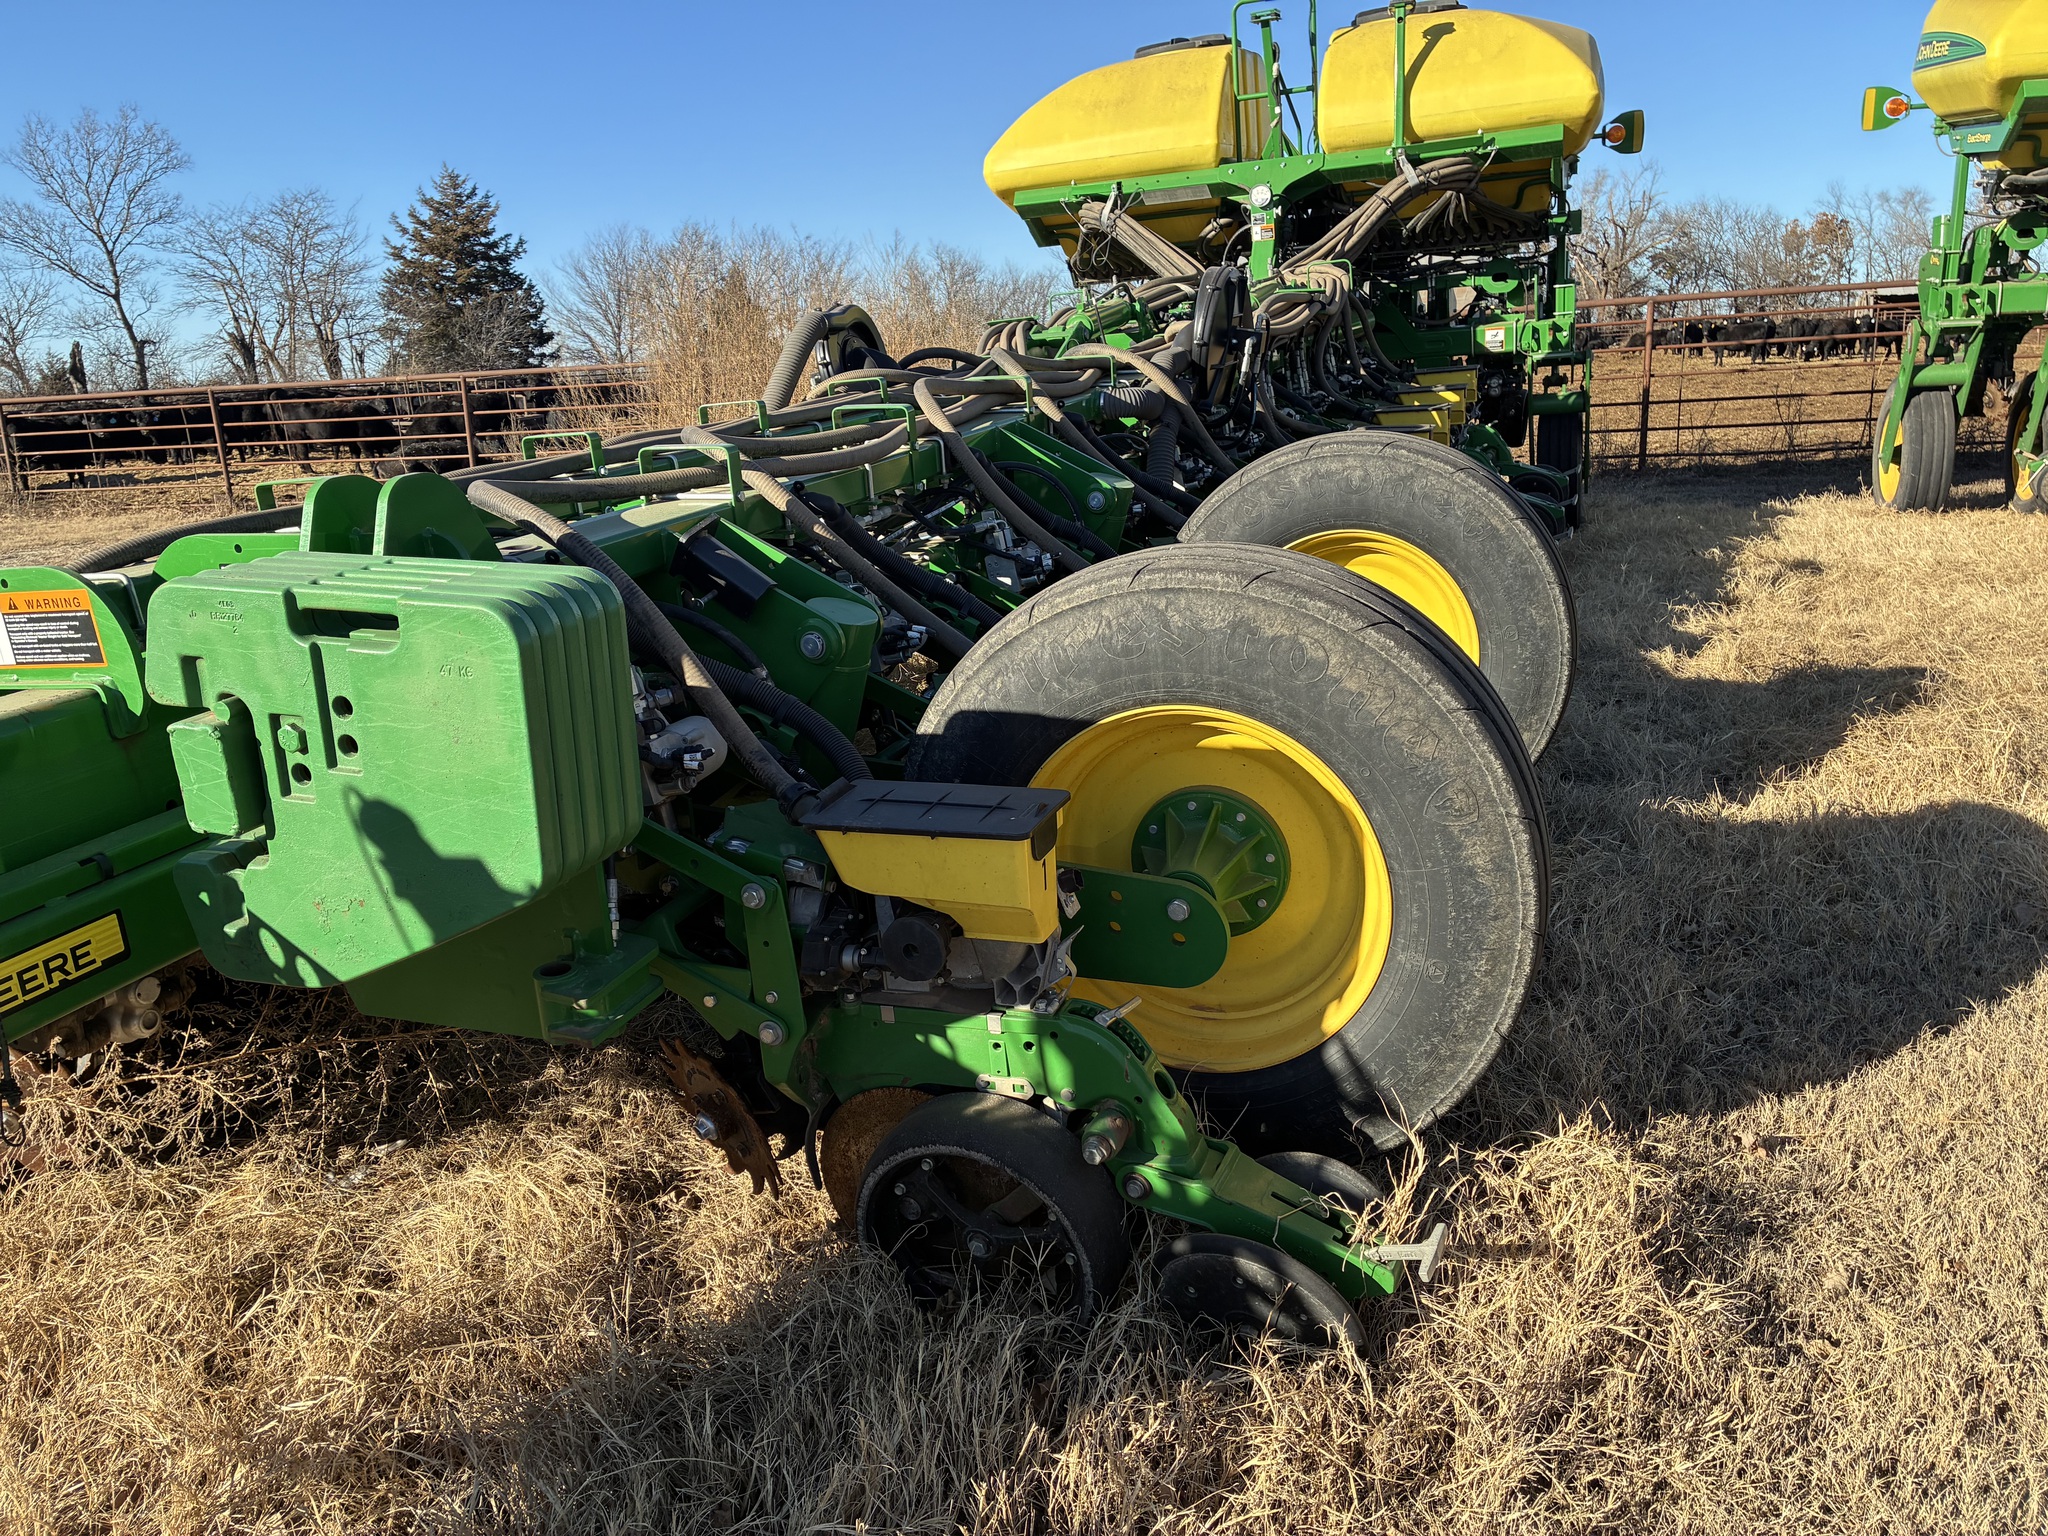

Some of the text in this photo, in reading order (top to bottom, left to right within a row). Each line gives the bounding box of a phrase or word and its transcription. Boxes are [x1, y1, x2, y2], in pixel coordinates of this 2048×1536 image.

[1930, 40, 1950, 58] DEERE
[24, 597, 81, 610] WARNING
[440, 664, 474, 679] 47 KG
[1042, 858, 1047, 891] 1
